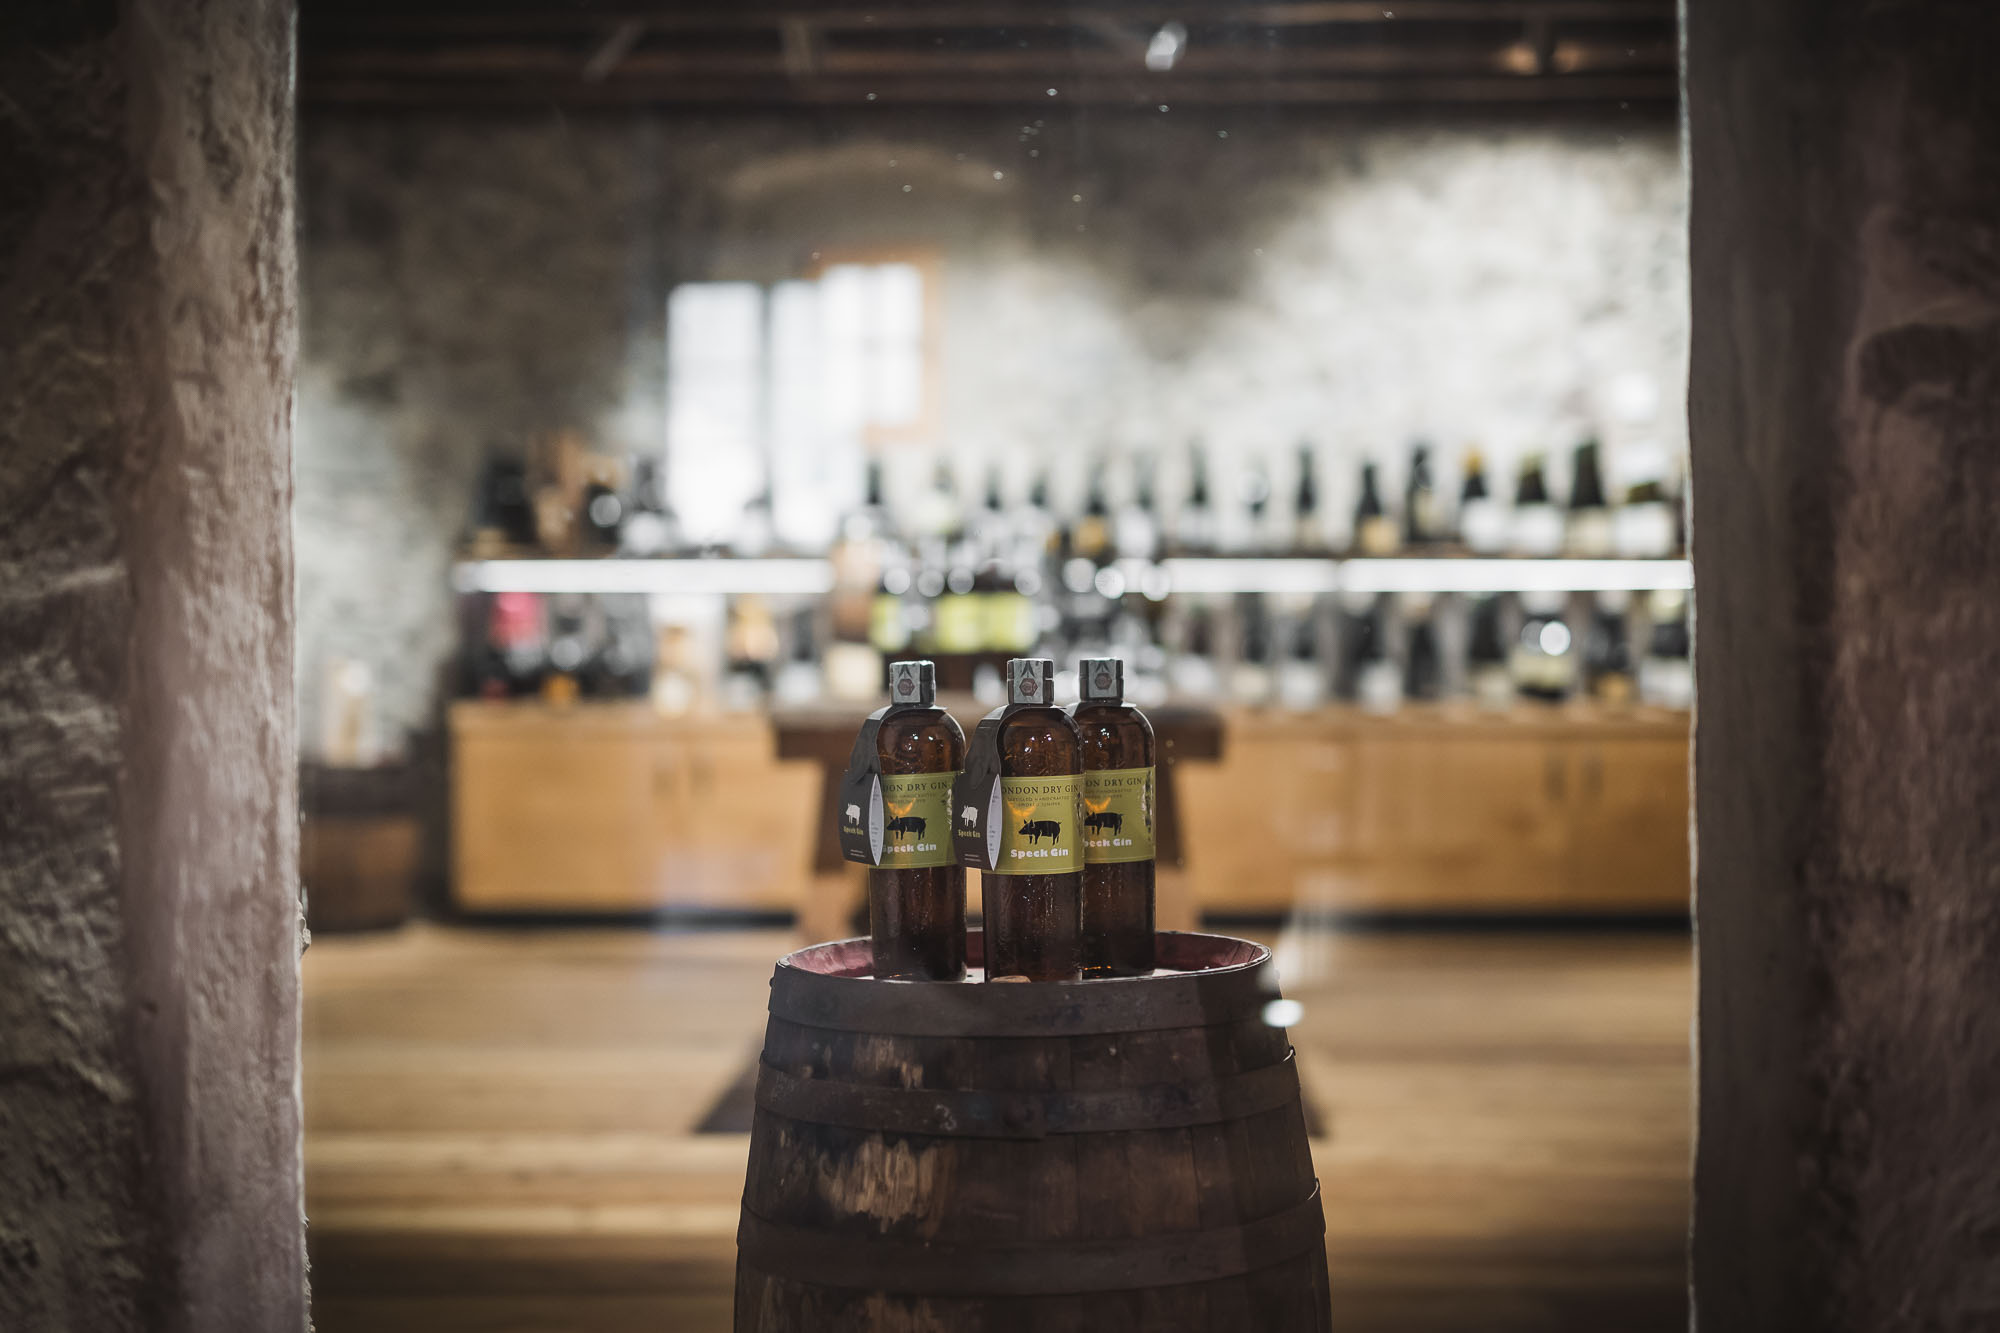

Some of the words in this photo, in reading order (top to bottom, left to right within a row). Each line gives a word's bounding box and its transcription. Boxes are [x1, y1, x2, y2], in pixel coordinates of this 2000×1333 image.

[907, 783, 927, 792] DRY
[930, 781, 947, 790] GIN
[1104, 779, 1123, 787] DRY
[1126, 777, 1141, 786] GIN
[1001, 786, 1038, 795] ONDON
[1042, 785, 1061, 794] DRY
[1064, 784, 1078, 793] GIN
[916, 843, 936, 852] Gin
[1113, 838, 1132, 847] Gin
[1010, 849, 1048, 860] Speck
[1049, 847, 1068, 857] Gin
